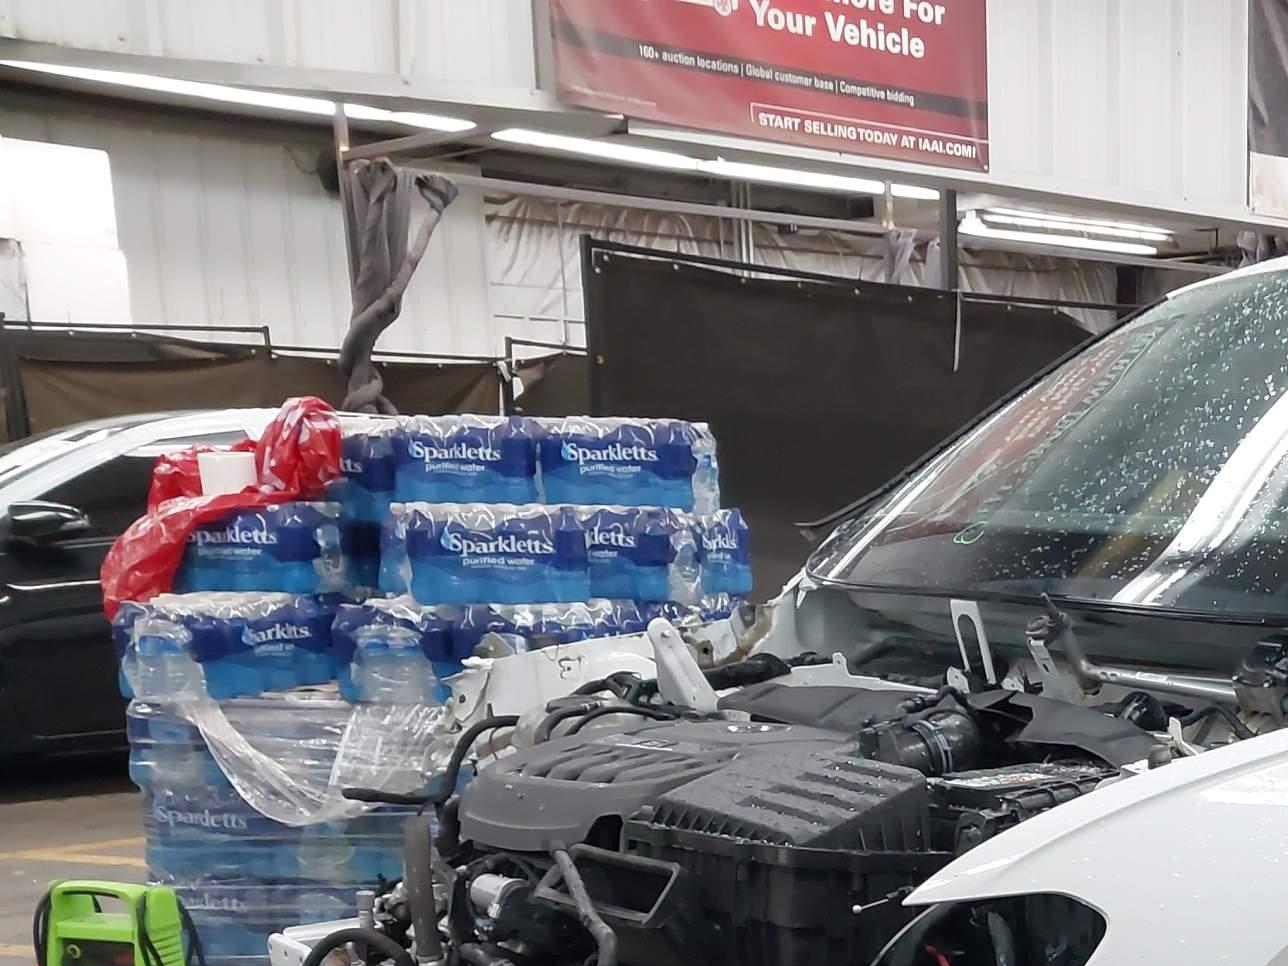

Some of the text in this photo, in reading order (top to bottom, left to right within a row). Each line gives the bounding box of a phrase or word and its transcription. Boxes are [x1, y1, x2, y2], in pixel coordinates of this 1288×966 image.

[903, 0, 946, 25] For
[749, 0, 925, 58] Your Vehicle
[662, 51, 696, 67] auction
[697, 55, 739, 74] locations
[745, 63, 773, 81] Global
[775, 71, 813, 87] customer
[814, 77, 834, 91] base
[840, 80, 886, 100] Competitive
[887, 89, 915, 107] bidding
[758, 112, 977, 159] START SELLING TODAY AT IAAI.COM!
[413, 441, 502, 463] Sparkletts
[567, 443, 660, 465] Sparkletts
[460, 463, 486, 472] water
[616, 465, 642, 473] water
[450, 532, 557, 557] Sparkletts
[462, 557, 535, 567] purified water
